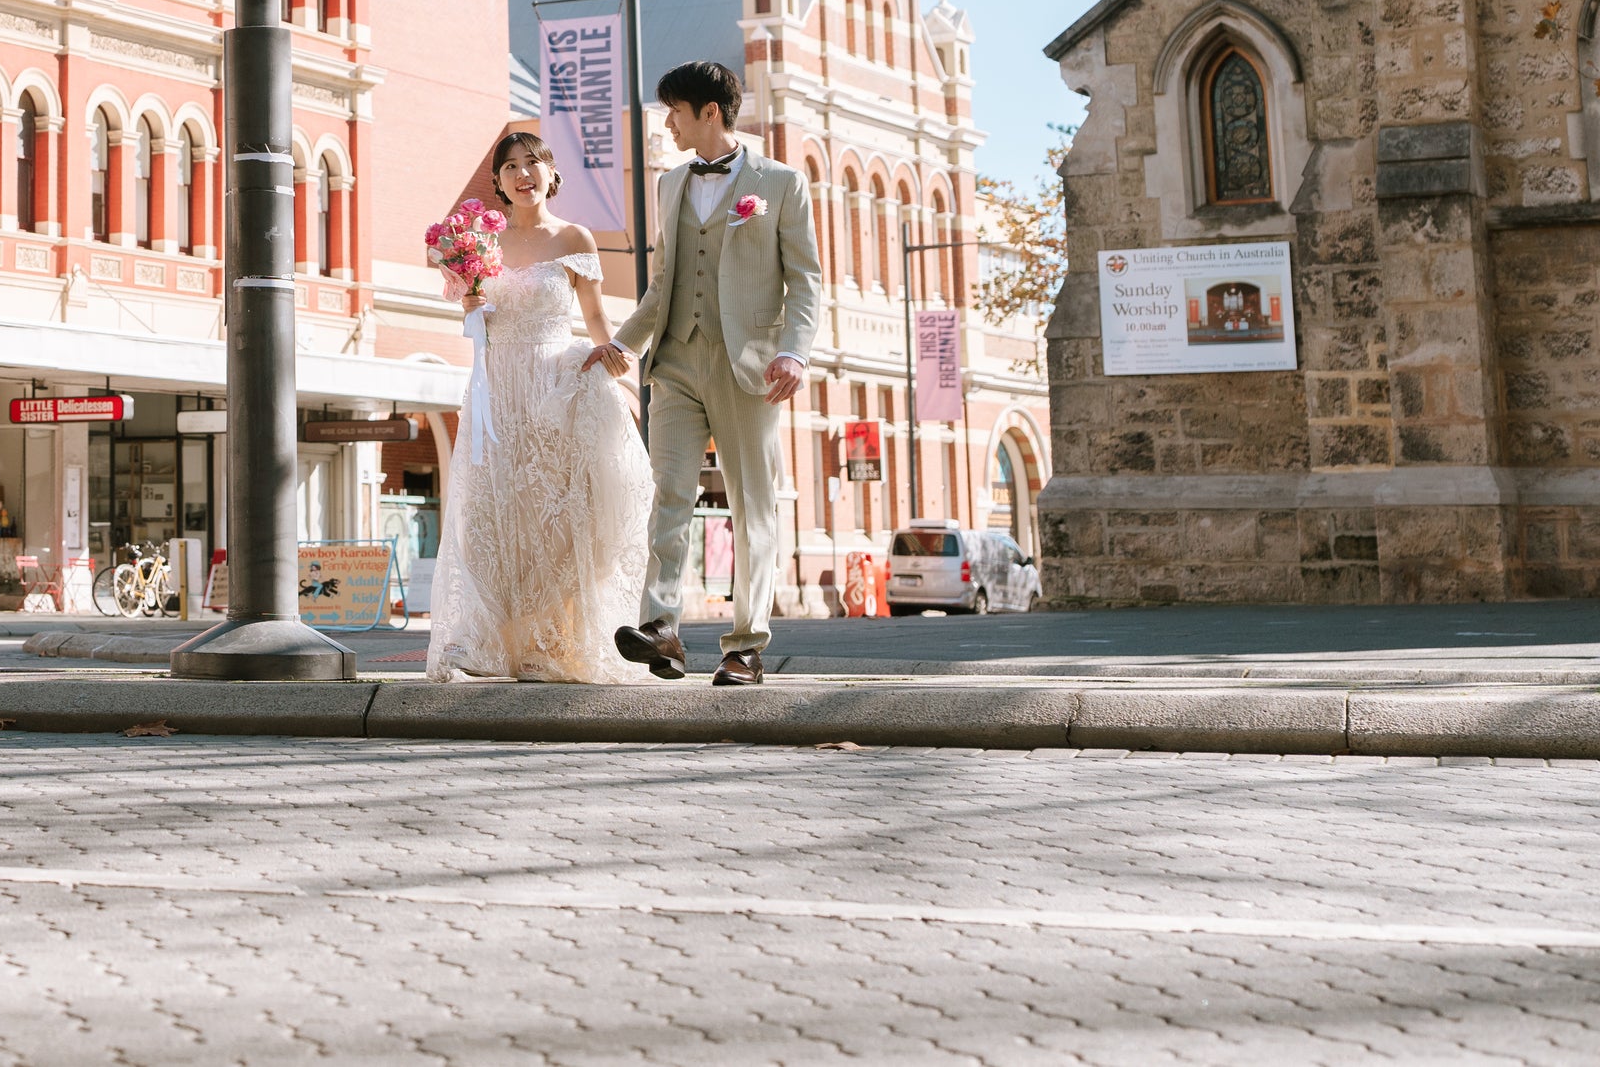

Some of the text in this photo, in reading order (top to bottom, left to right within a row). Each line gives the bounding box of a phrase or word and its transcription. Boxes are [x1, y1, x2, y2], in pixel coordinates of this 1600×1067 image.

[548, 29, 578, 116] THIS IS
[580, 25, 614, 169] FREMANTLE
[1133, 247, 1285, 266] Uniting Church in Australia
[1115, 283, 1173, 299] Sunday
[1112, 301, 1179, 319] Worship
[920, 316, 937, 362] THIS IS
[938, 315, 957, 388] FREMANTLE
[20, 399, 114, 413] LITTLE Delicatessen
[20, 411, 55, 422] SISTER
[340, 547, 388, 558] Karaoke
[322, 561, 353, 572] Family
[352, 593, 380, 604] Kids
[345, 609, 387, 621] Babis
